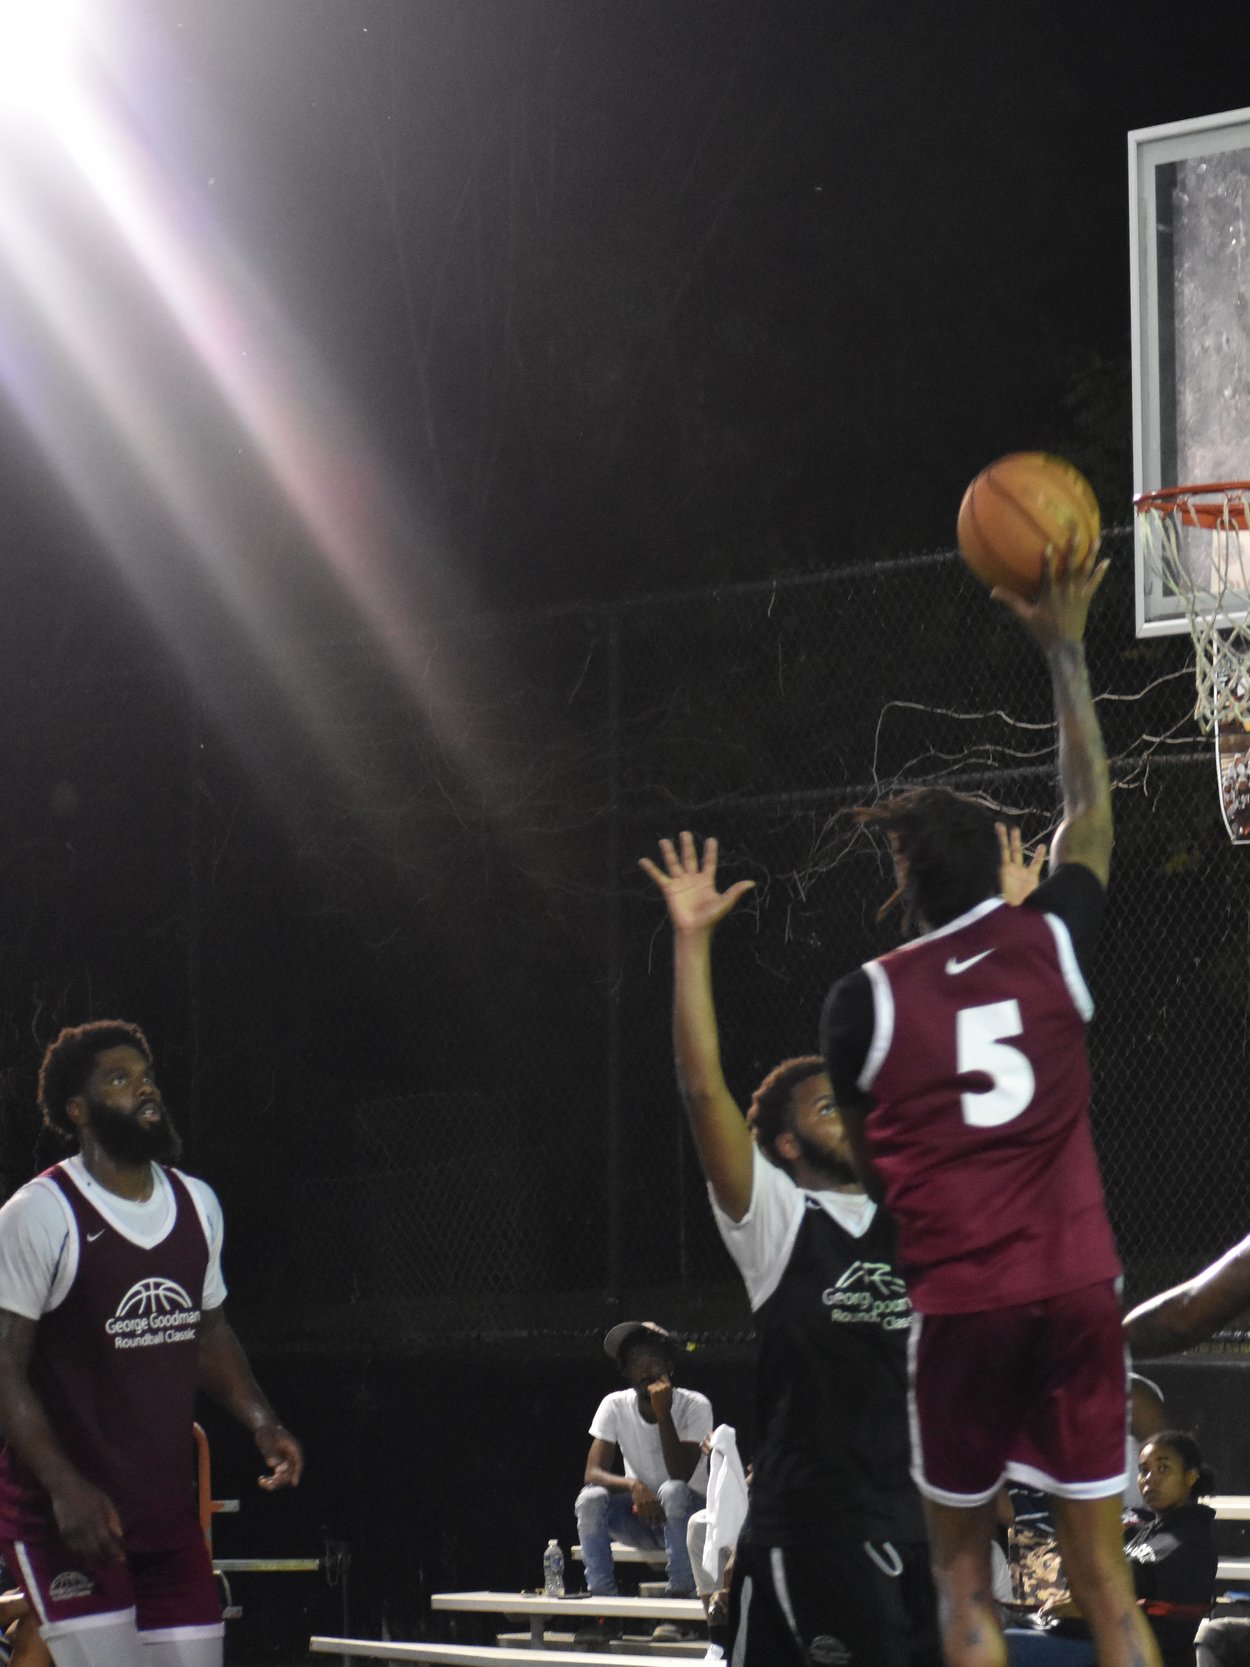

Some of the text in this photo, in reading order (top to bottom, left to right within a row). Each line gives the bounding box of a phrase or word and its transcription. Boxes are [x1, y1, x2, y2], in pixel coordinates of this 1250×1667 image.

[955, 998, 1036, 1128] 5
[822, 1287, 873, 1309] Georg
[105, 1310, 202, 1334] George Goodman
[114, 1328, 196, 1349] Roundball Classic
